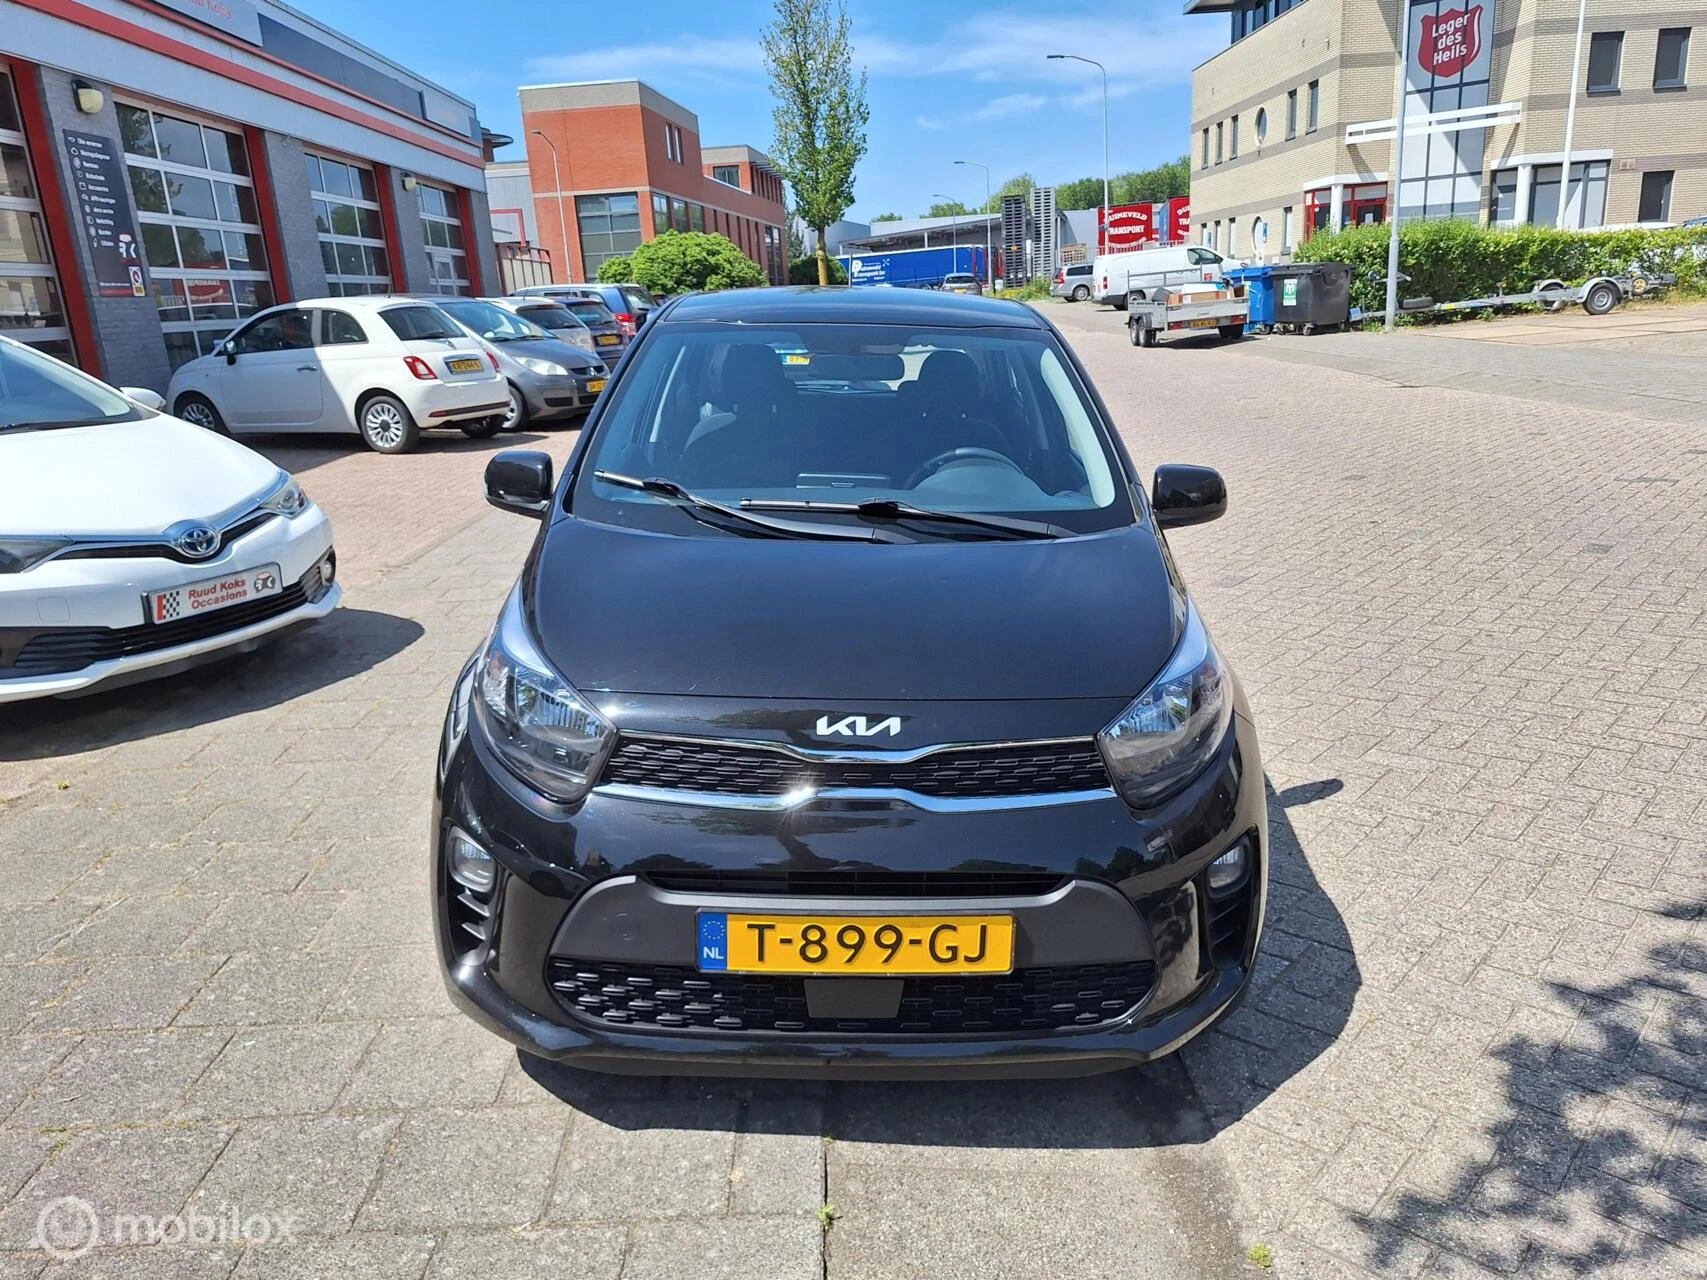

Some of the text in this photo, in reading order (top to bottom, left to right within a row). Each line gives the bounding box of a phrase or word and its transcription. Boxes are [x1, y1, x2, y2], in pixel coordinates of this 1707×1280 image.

[1432, 13, 1470, 38] Leger
[1438, 31, 1462, 50] des
[1432, 43, 1467, 66] Heils
[1104, 211, 1148, 223] UINEVELD
[188, 578, 246, 600] Ruud Koks
[191, 588, 248, 609] Occasions
[816, 715, 901, 737] KIA
[703, 946, 724, 960] NL
[746, 923, 988, 964] T-899-GJ
